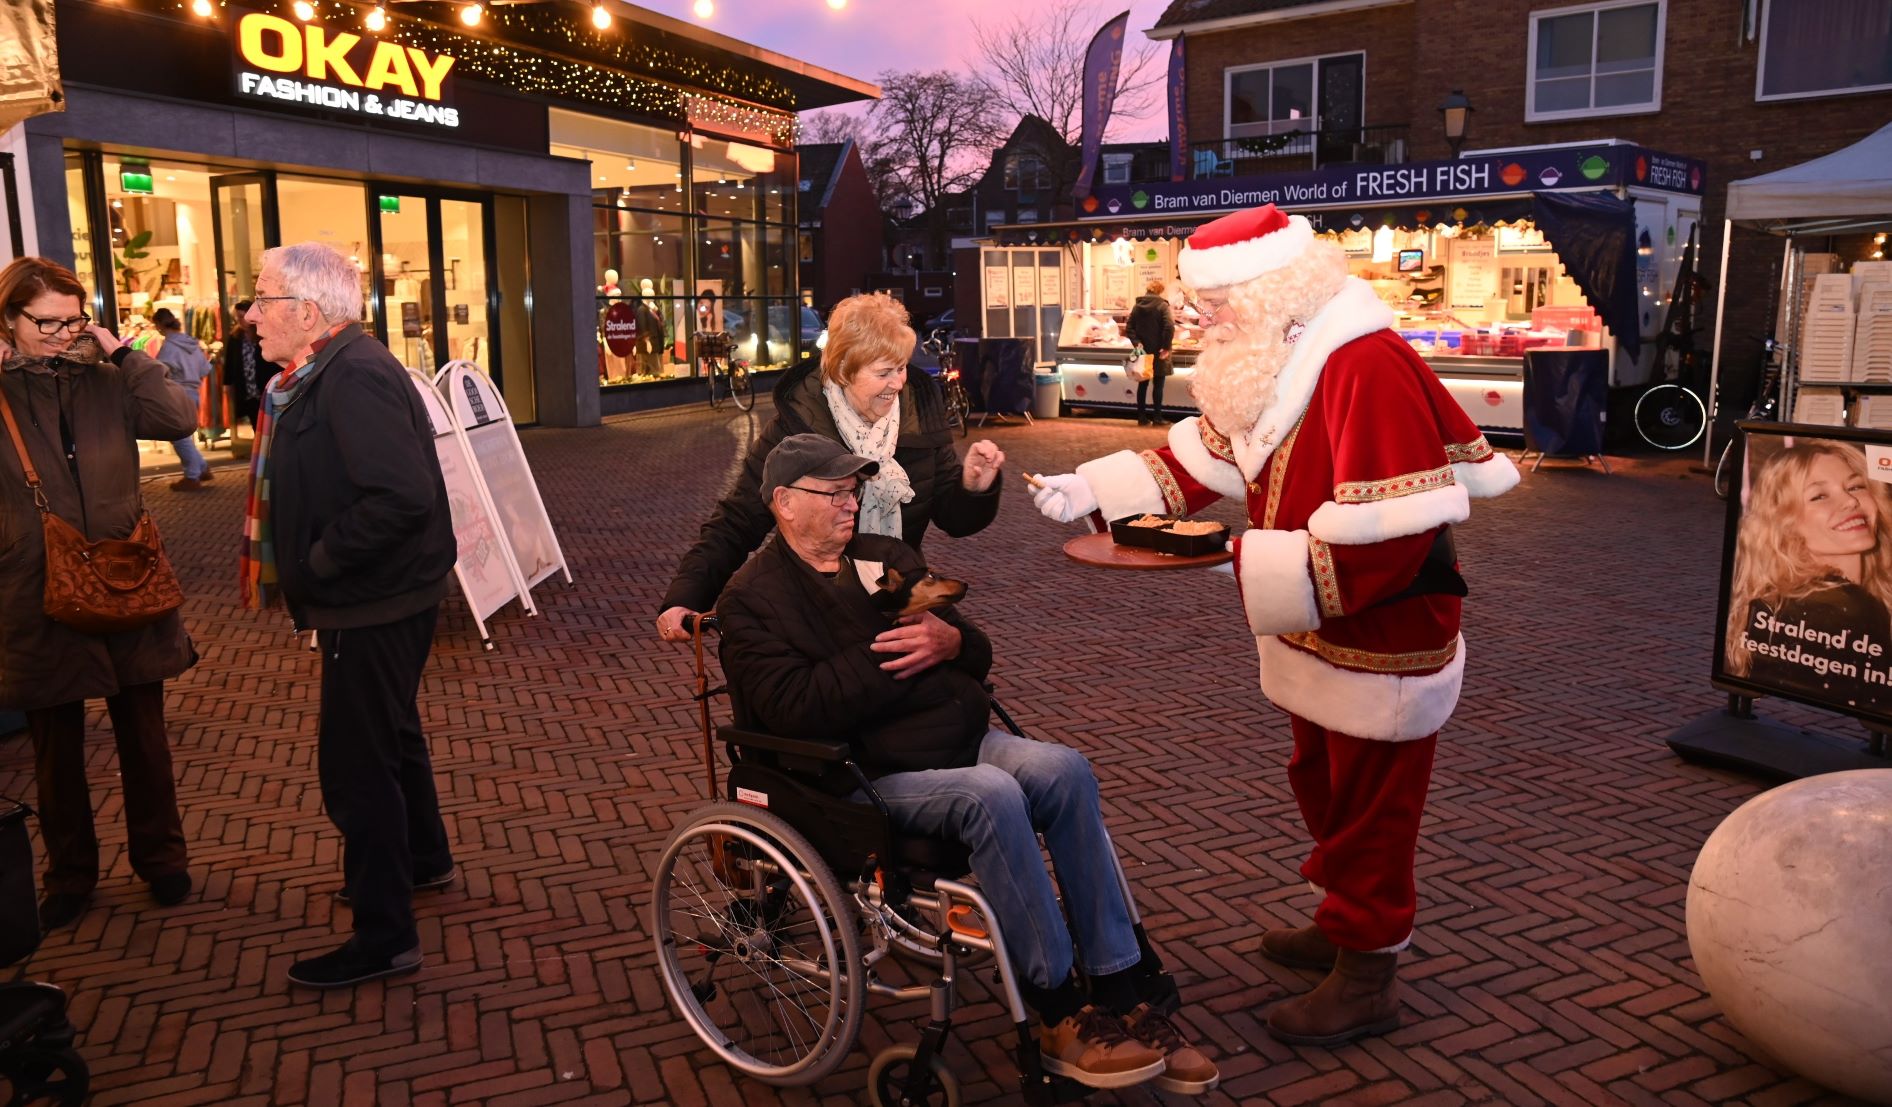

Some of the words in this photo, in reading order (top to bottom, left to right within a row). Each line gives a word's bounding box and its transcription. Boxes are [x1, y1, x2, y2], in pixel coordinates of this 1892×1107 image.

[239, 12, 456, 101] OKAY
[239, 72, 360, 111] FASHION
[364, 94, 384, 115] &
[387, 99, 459, 127] JEANS
[1154, 194, 1189, 209] Bram
[1193, 195, 1216, 206] van
[1220, 189, 1279, 205] Diermen
[1284, 185, 1326, 200] World
[1331, 183, 1347, 198] of
[1355, 169, 1427, 196] FRESH
[1436, 163, 1489, 190] FISH
[1650, 166, 1672, 186] FRESH
[1672, 169, 1686, 189] FISH
[1122, 228, 1145, 237] Bram
[1149, 228, 1164, 236] van
[1167, 225, 1197, 235] Dierme
[1306, 214, 1323, 228] SH
[606, 319, 636, 331] Stralend
[1753, 610, 1848, 650] Stralend
[1852, 631, 1883, 657] de
[1739, 631, 1857, 678] feestdagen
[1864, 662, 1892, 687] in!
